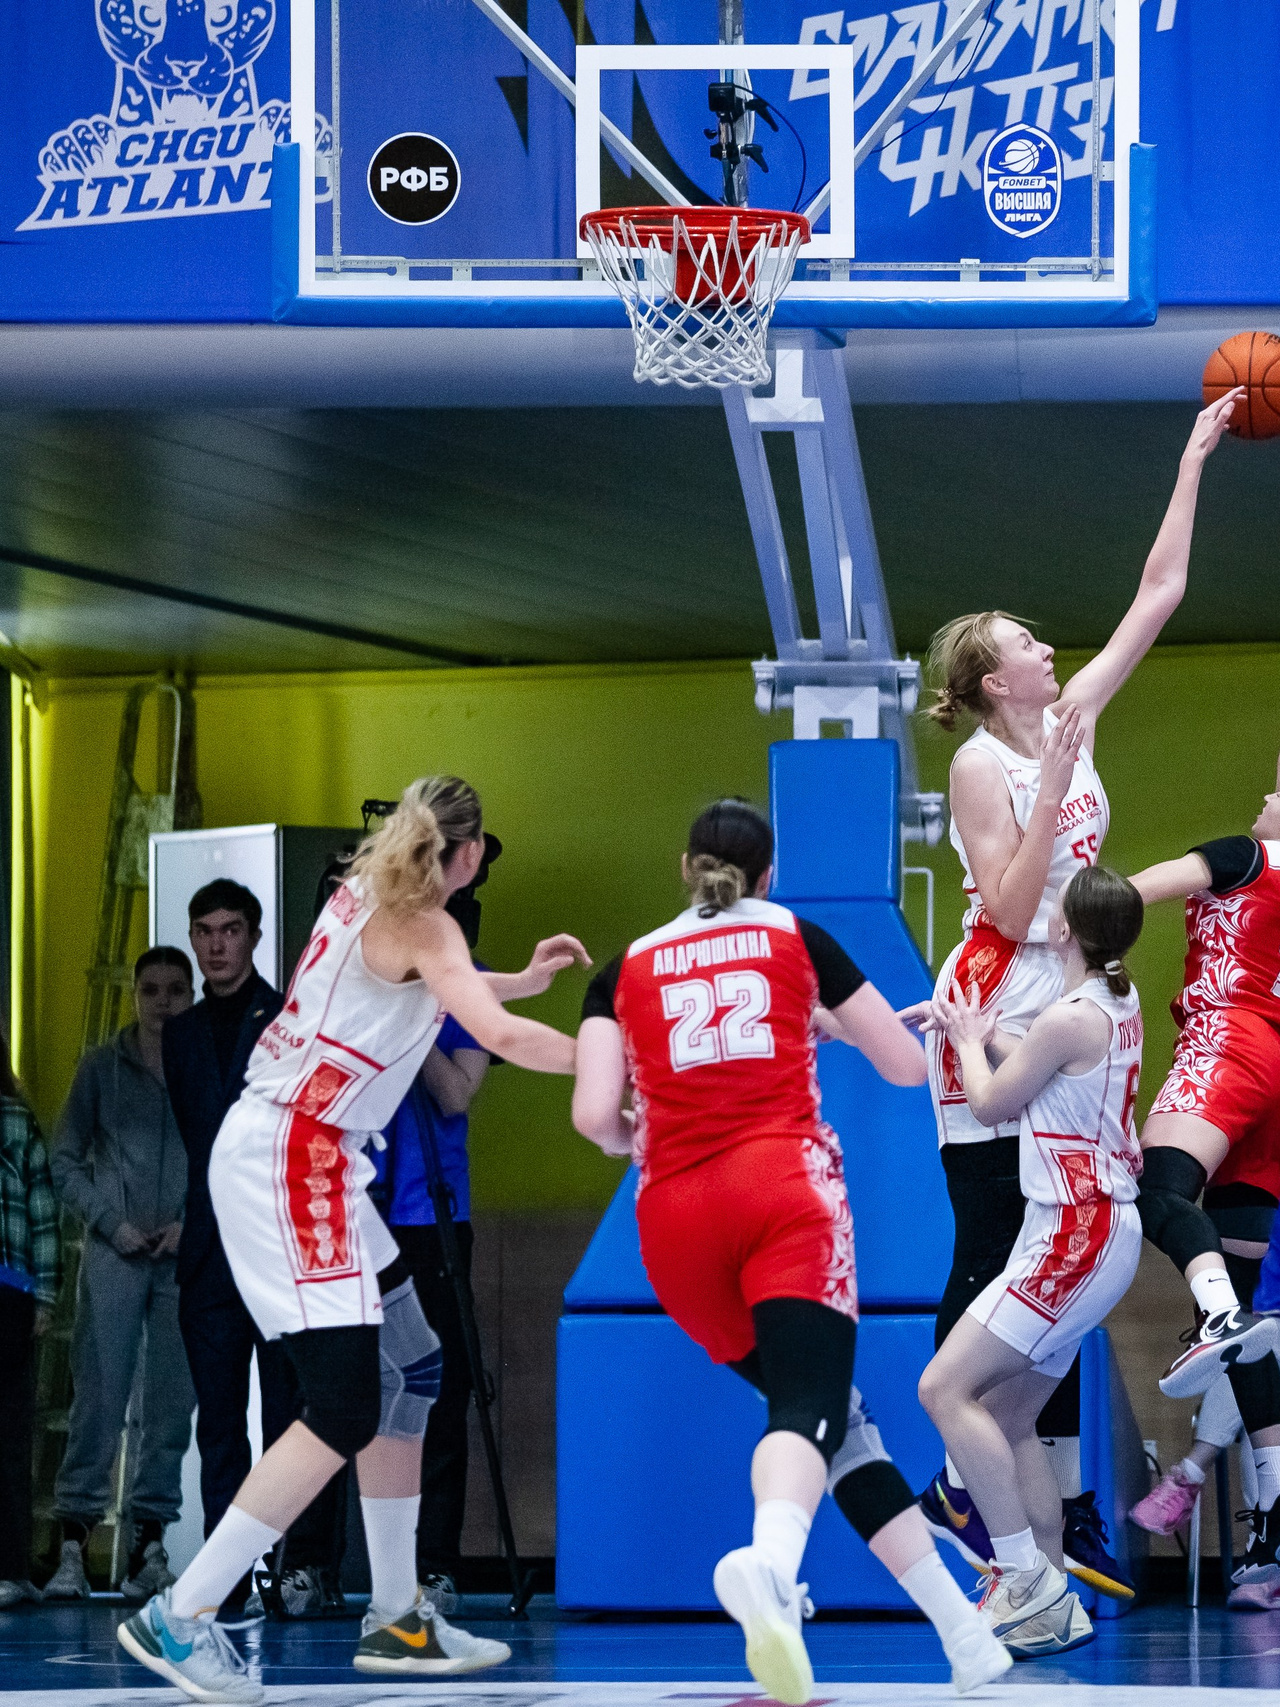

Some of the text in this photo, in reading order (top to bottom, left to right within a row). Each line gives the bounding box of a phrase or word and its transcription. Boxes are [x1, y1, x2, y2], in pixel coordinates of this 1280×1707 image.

[115, 122, 256, 168] CHGU
[380, 167, 449, 192] РФБ
[1002, 178, 1042, 187] FONBET
[994, 192, 1052, 210] ВЫСШАЯ
[1004, 213, 1042, 222] ЛИГА
[652, 930, 772, 977] АНДРЮШКИНА
[660, 969, 776, 1074] 22
